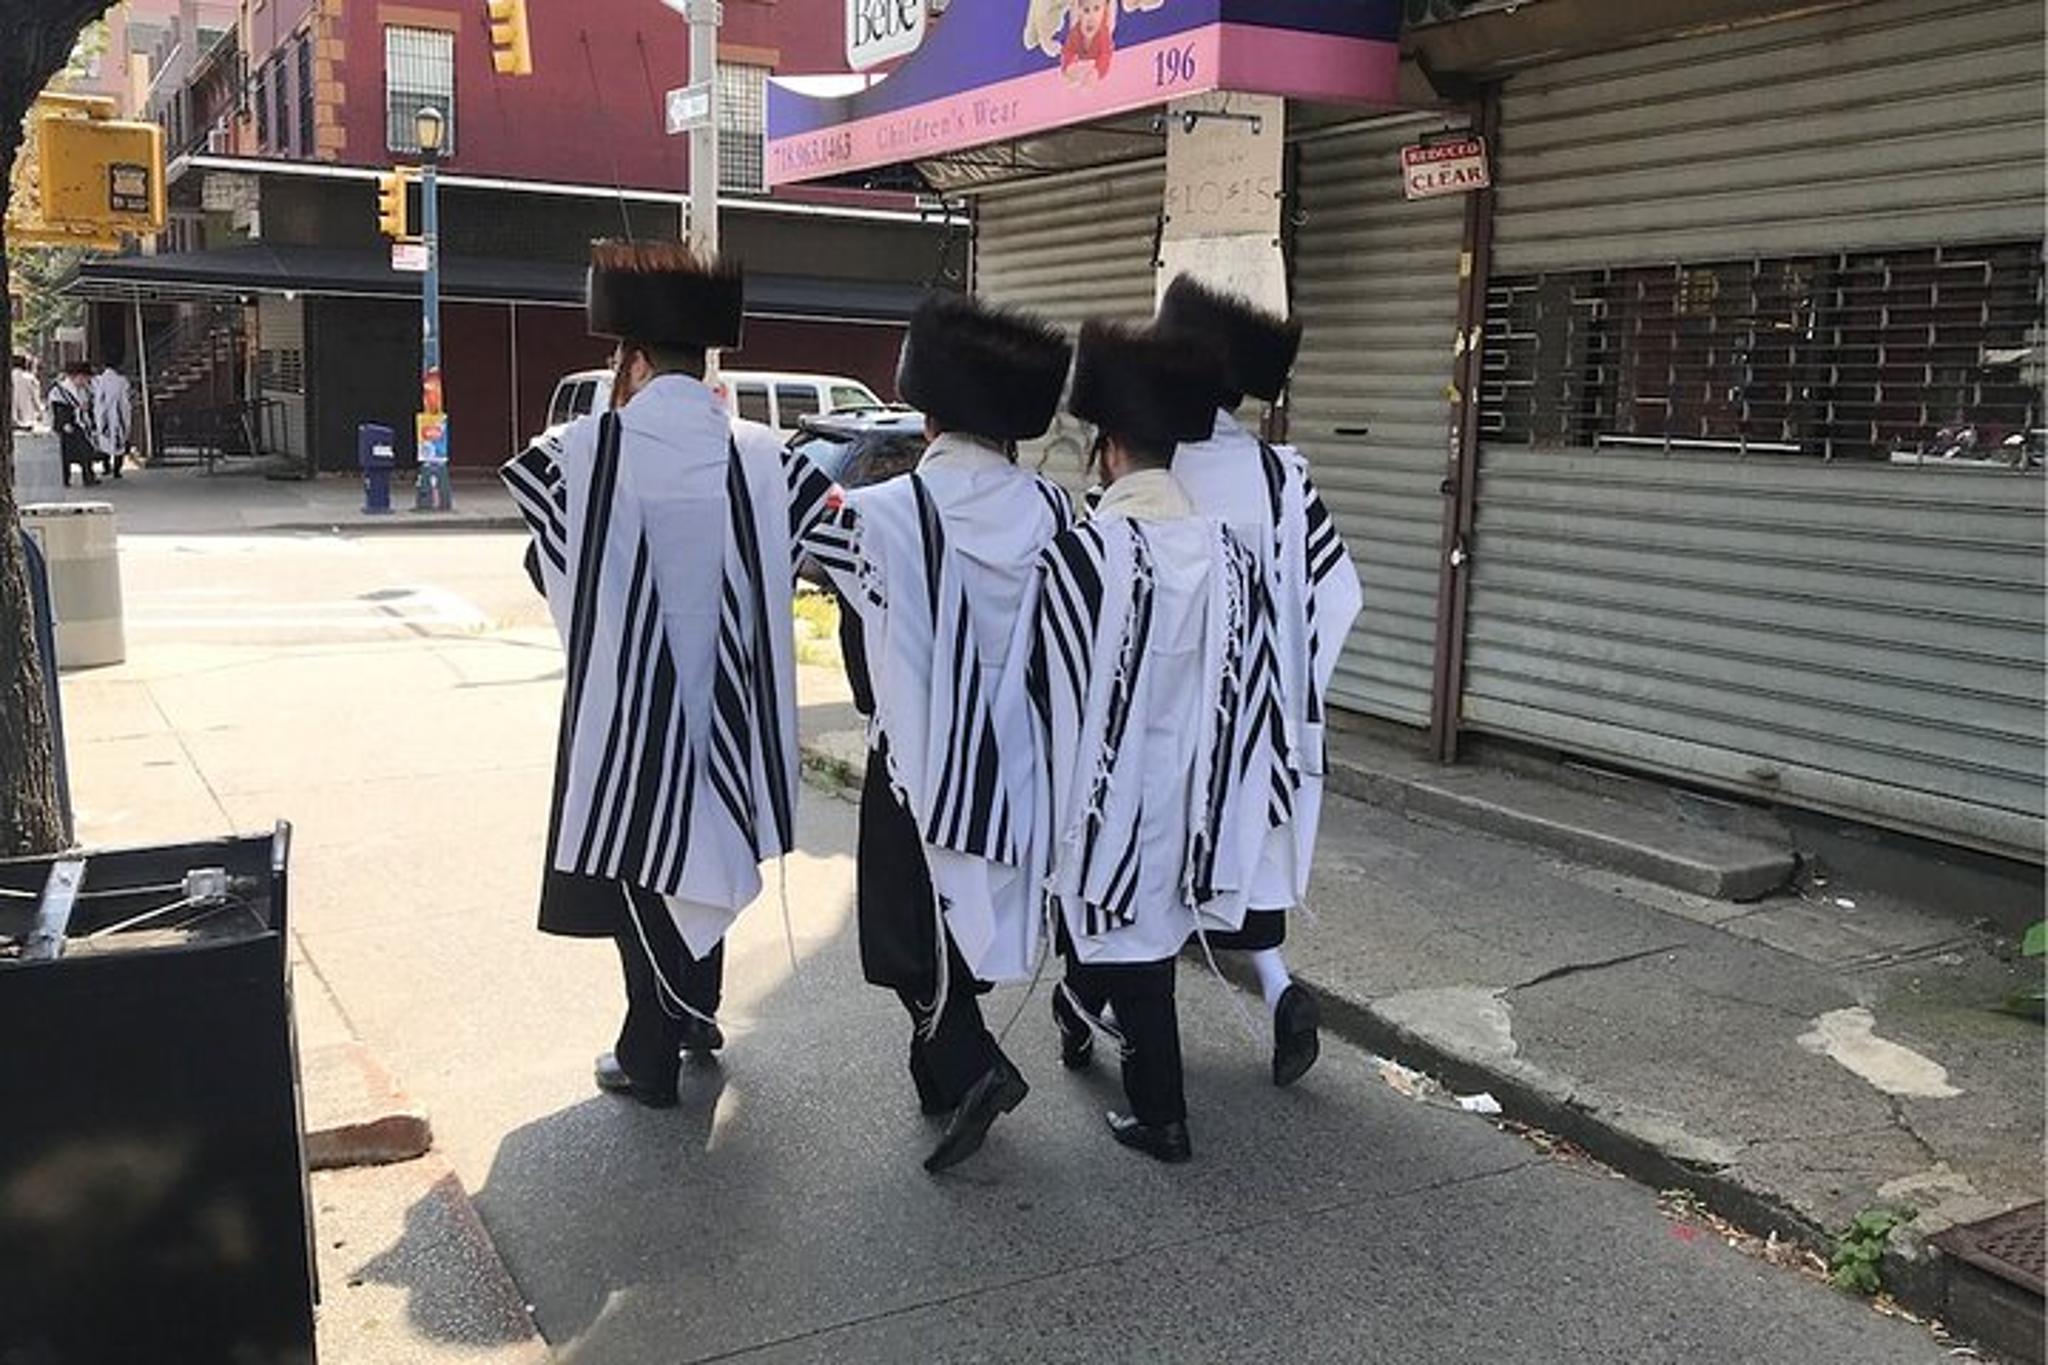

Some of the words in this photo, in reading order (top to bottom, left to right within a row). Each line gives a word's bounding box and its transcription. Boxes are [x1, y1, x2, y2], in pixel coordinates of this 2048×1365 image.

[1157, 42, 1195, 86] 196
[876, 107, 966, 148] Children's
[972, 99, 1020, 126] Wear
[1407, 142, 1479, 163] REDUCED
[1413, 167, 1481, 191] CLEAR
